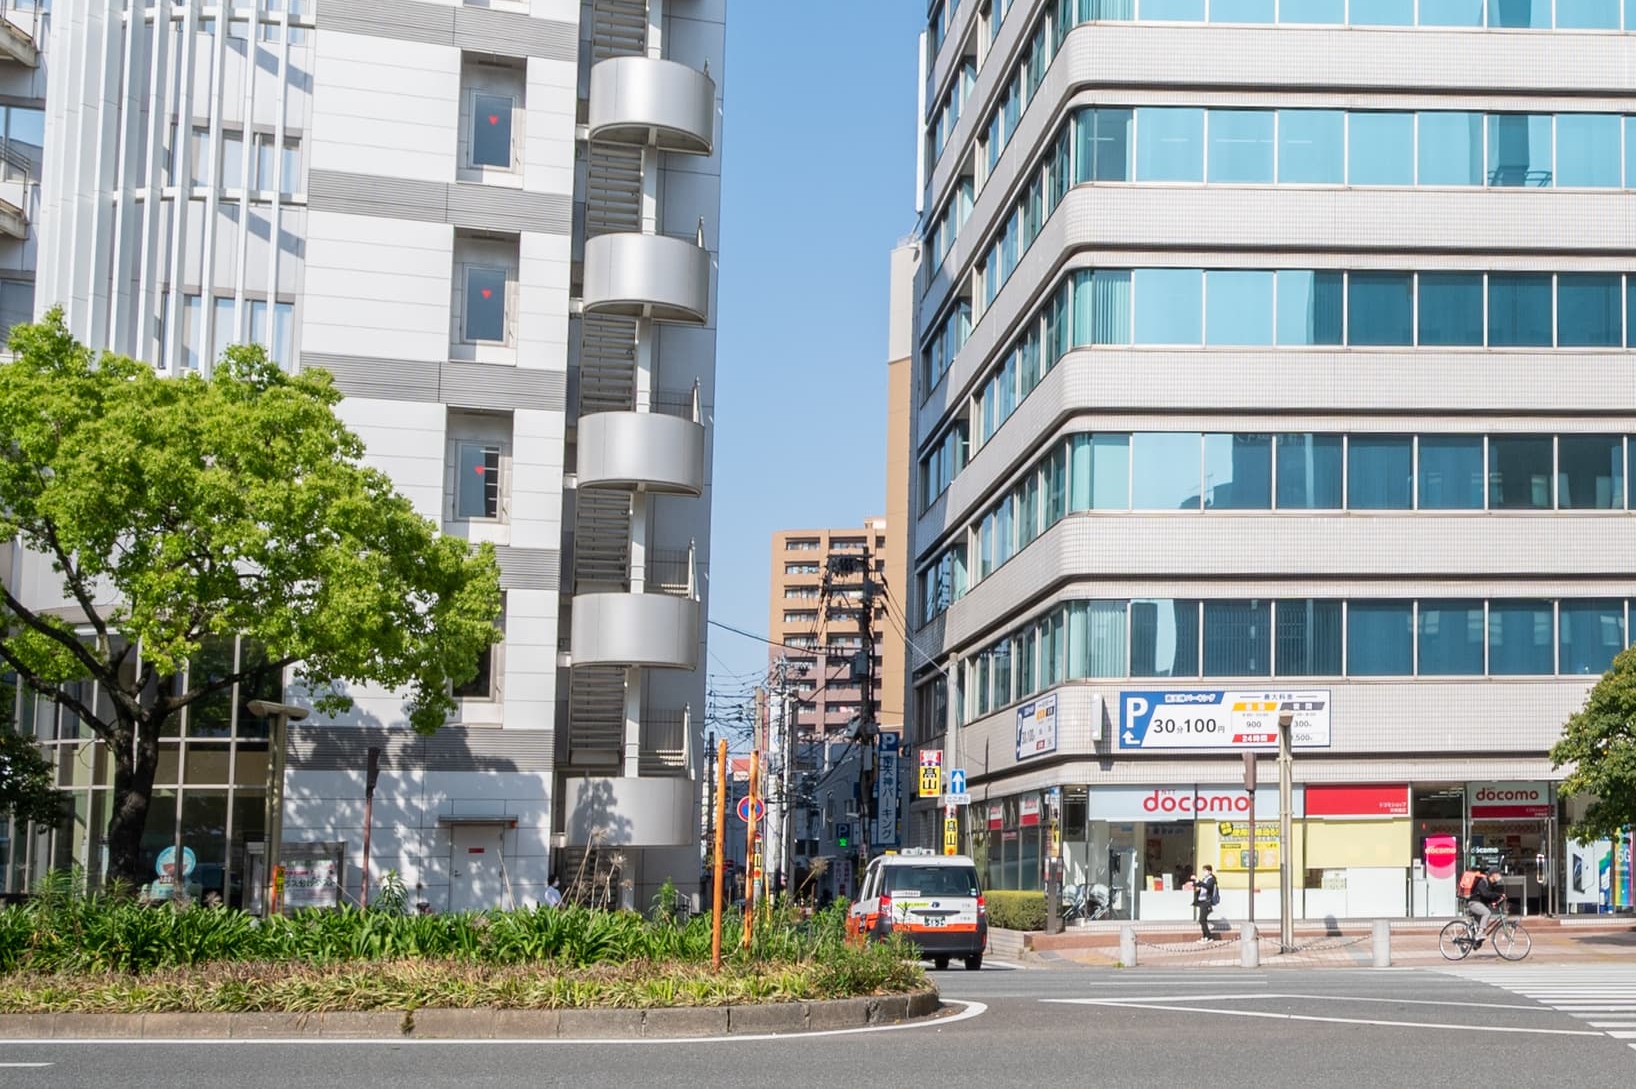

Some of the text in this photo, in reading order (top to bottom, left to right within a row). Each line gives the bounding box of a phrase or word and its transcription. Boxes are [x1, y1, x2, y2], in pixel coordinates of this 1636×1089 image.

[1126, 697, 1149, 729] P
[882, 734, 896, 750] P
[882, 755, 894, 840] 南天神パーキング
[1143, 789, 1250, 812] docomo
[1476, 787, 1539, 801] docomo
[839, 825, 848, 837] P
[1425, 845, 1457, 854] docomo
[1617, 848, 1631, 863] 5G
